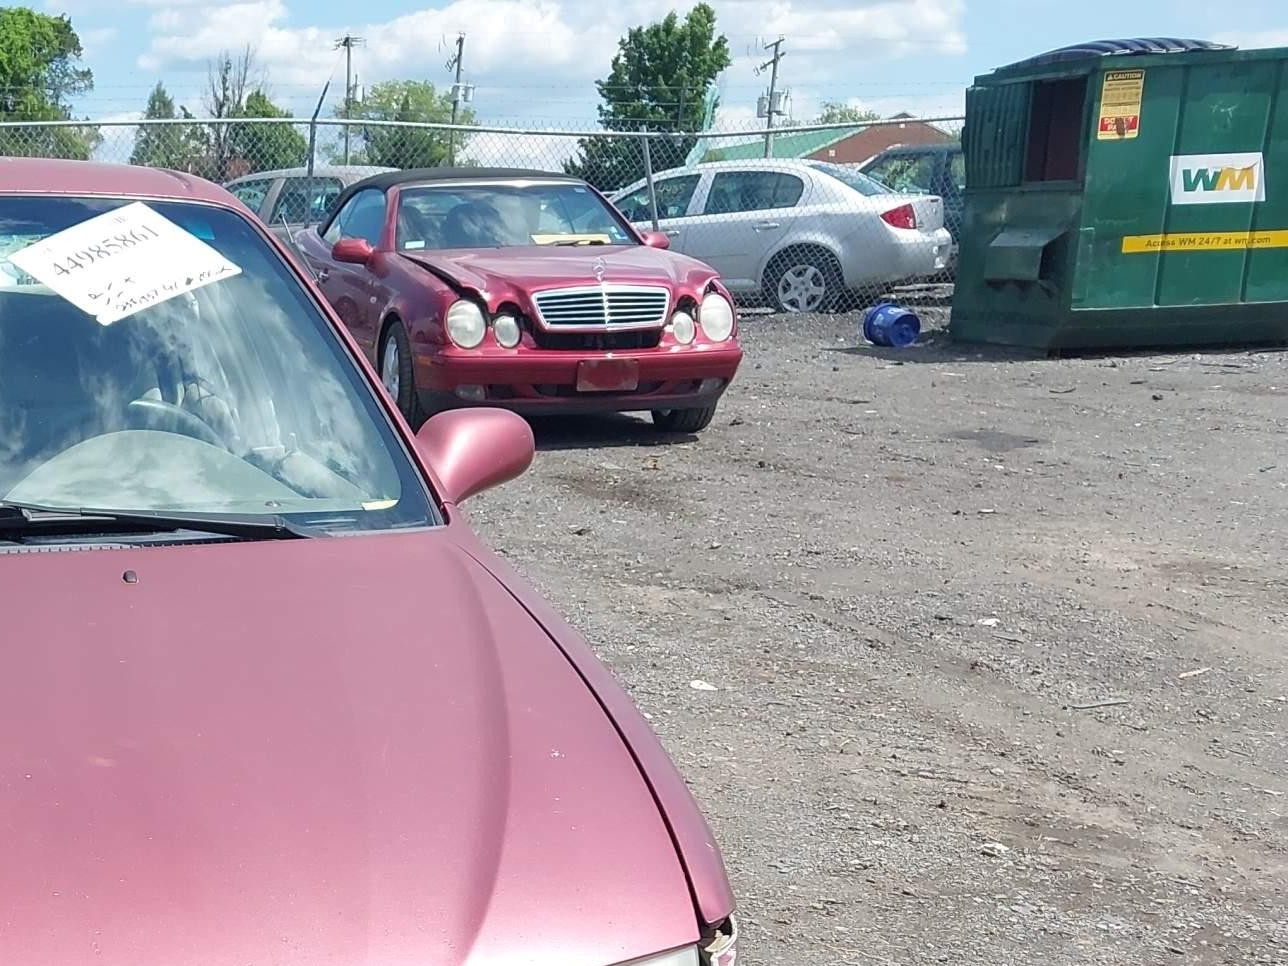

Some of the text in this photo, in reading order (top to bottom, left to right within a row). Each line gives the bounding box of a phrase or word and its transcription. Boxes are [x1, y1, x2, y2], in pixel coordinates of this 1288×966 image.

[1182, 167, 1255, 192] WM
[51, 224, 160, 278] 44985861
[1145, 238, 1176, 248] Access
[1179, 237, 1196, 246] WM
[1198, 236, 1222, 246] 24/7
[1223, 236, 1232, 245] at
